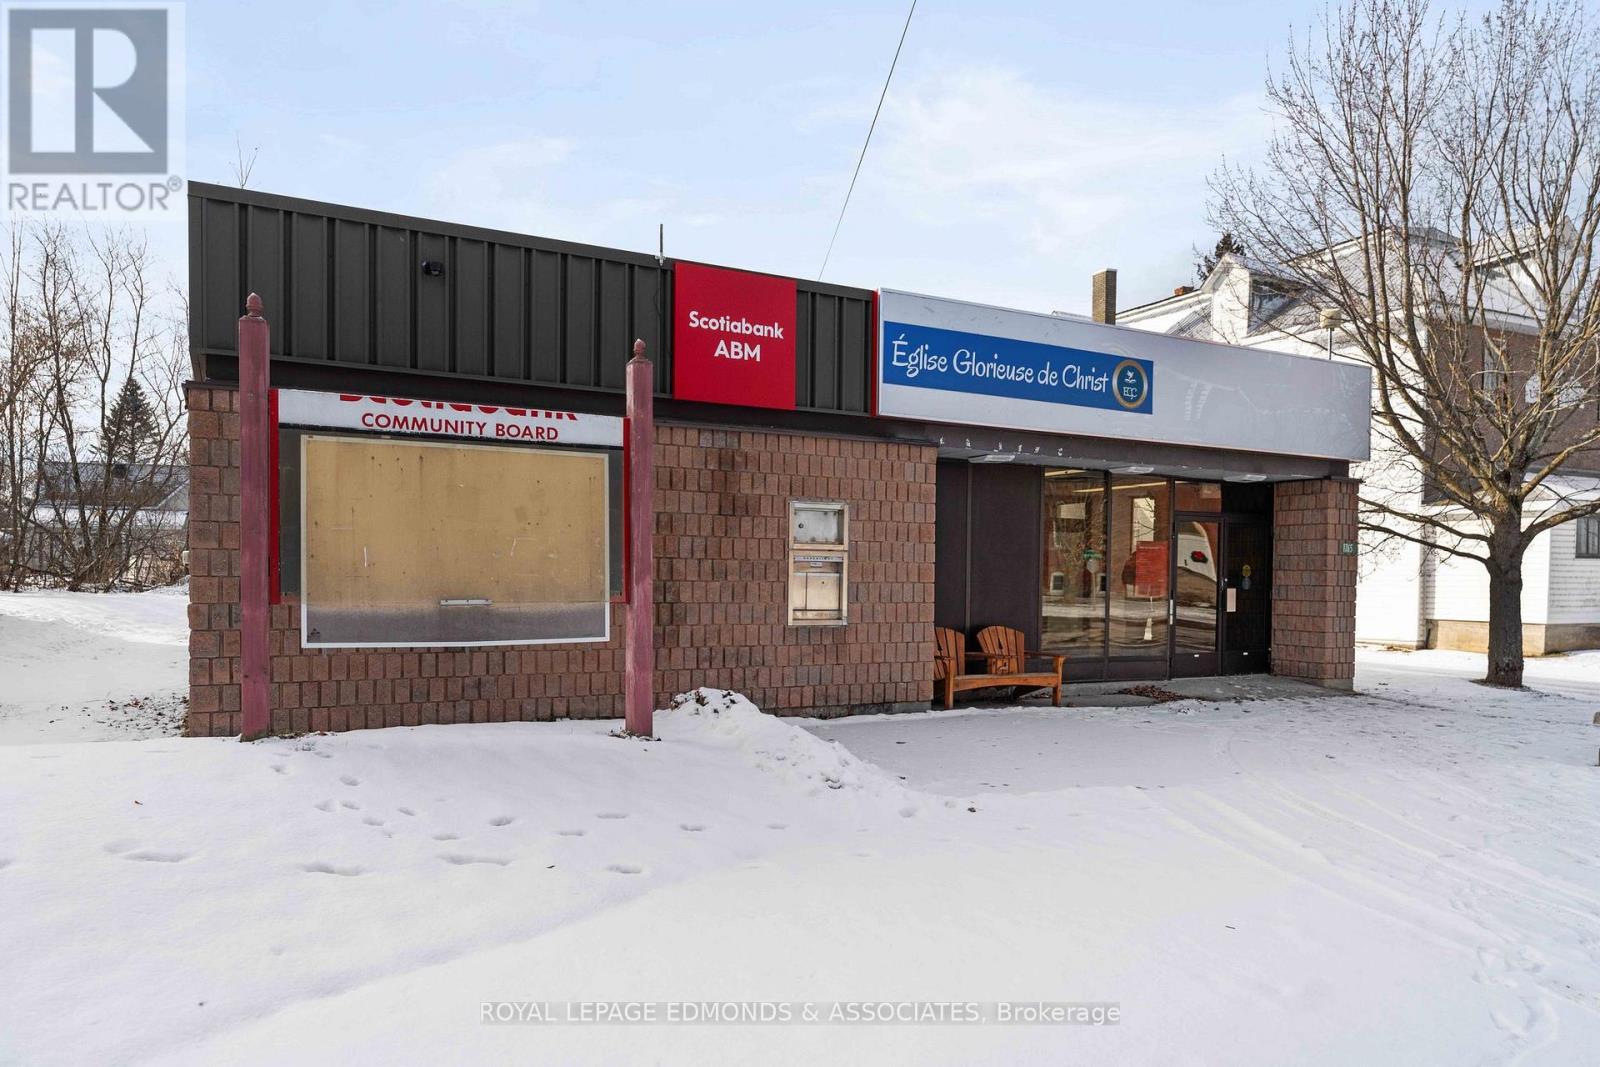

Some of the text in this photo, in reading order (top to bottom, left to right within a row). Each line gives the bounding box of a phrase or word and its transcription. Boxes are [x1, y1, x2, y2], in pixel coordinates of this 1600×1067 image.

[689, 310, 784, 339] Scotiabank
[714, 339, 761, 362] ABM
[891, 333, 1109, 393] Église Glorieuse de Christ
[361, 412, 559, 441] COMMUNITY BOARD
